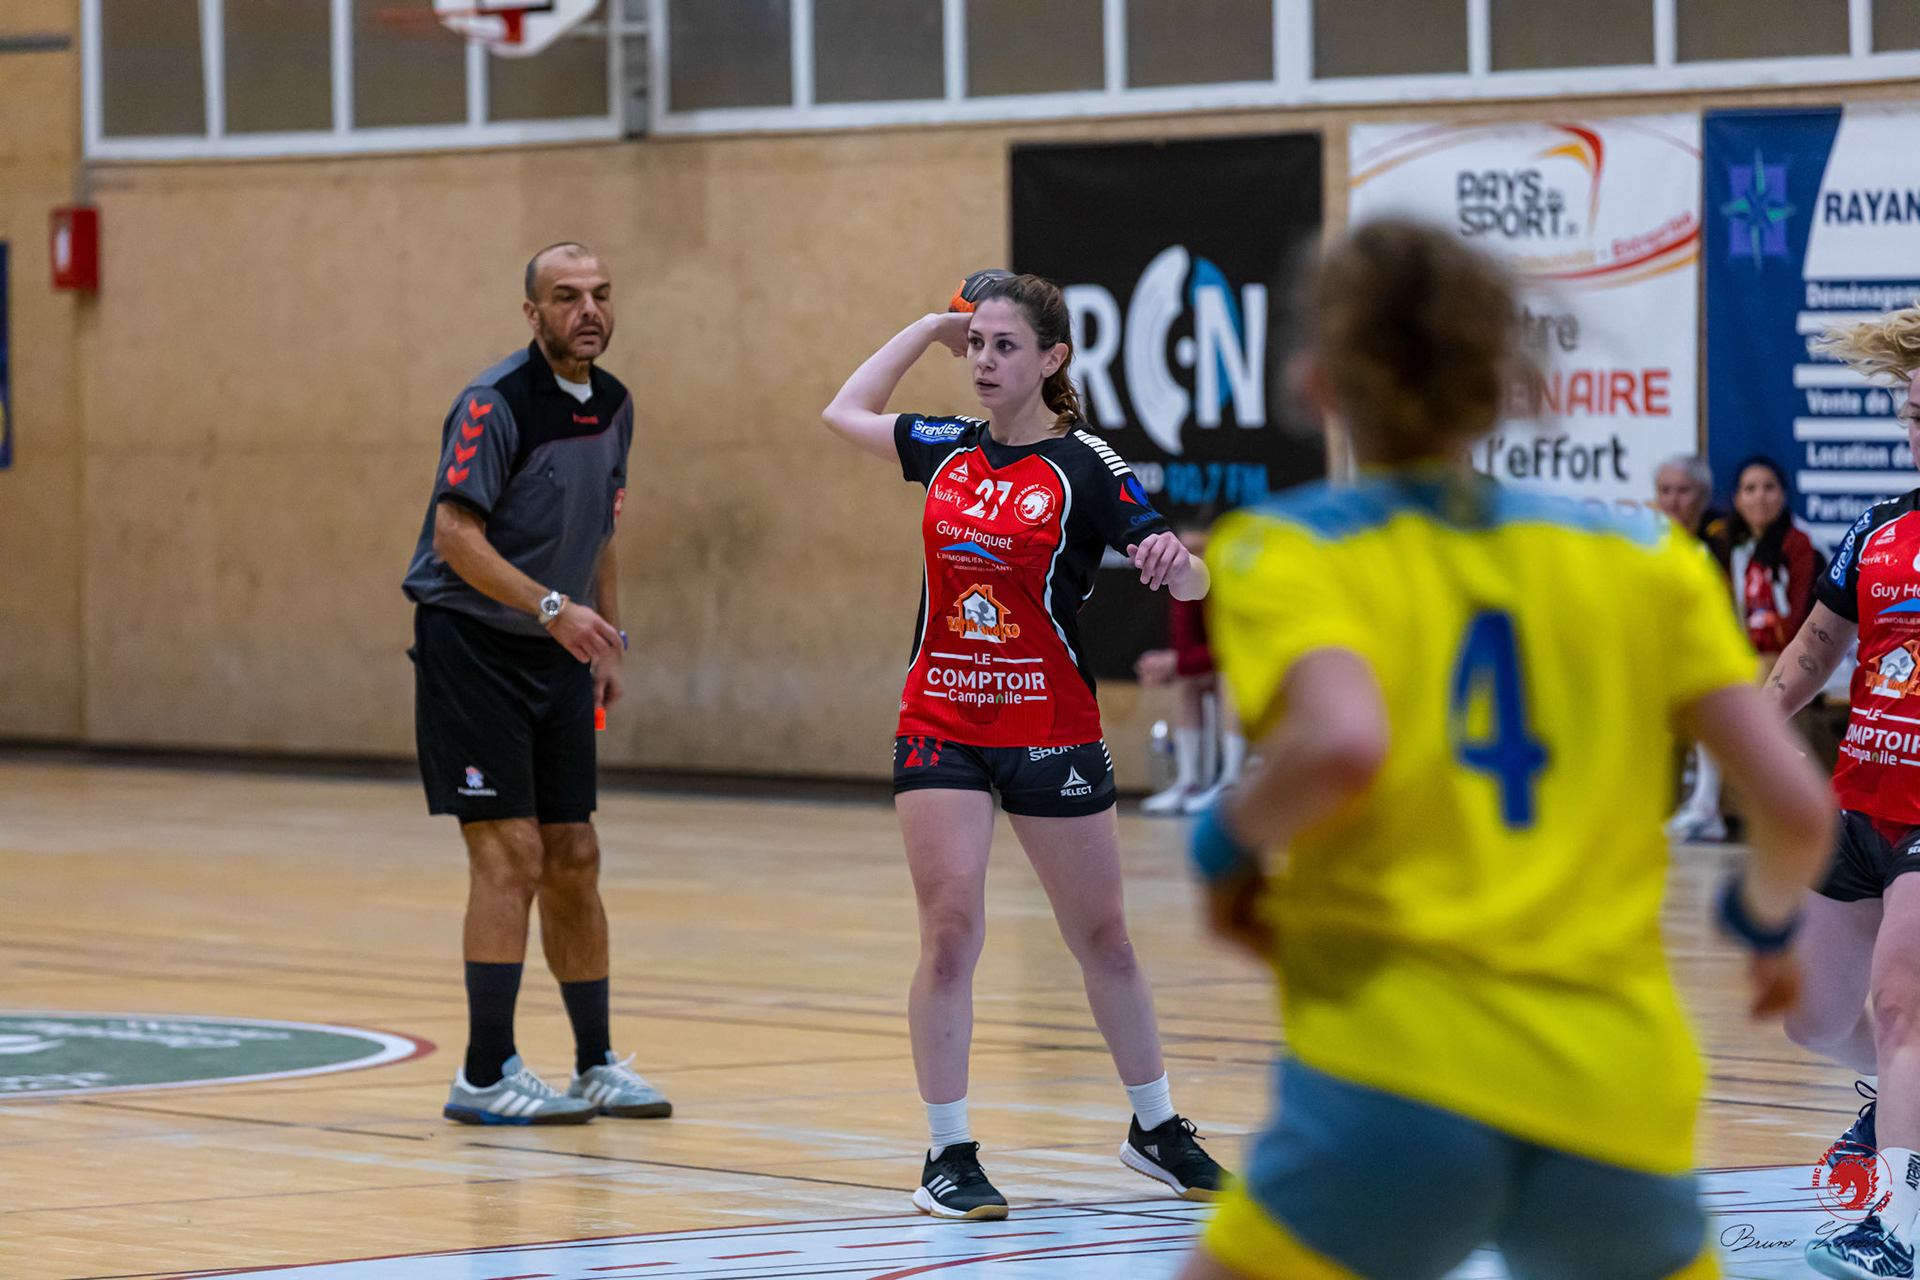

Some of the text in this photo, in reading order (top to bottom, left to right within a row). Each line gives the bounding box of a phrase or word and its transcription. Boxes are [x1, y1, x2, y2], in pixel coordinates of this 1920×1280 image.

[1457, 169, 1542, 201] PAYS
[1806, 441, 1890, 468] Location
[948, 472, 968, 483] SELECT
[961, 478, 1014, 521] 27
[936, 520, 1013, 550] Guy Hoquet
[1870, 582, 1900, 600] Guy
[974, 652, 991, 665] LE
[927, 667, 1045, 690] COMPTOIR
[948, 688, 1022, 707] Campanile
[1450, 607, 1553, 830] 4
[1866, 707, 1882, 721] LE
[1060, 785, 1092, 797] SELECT
